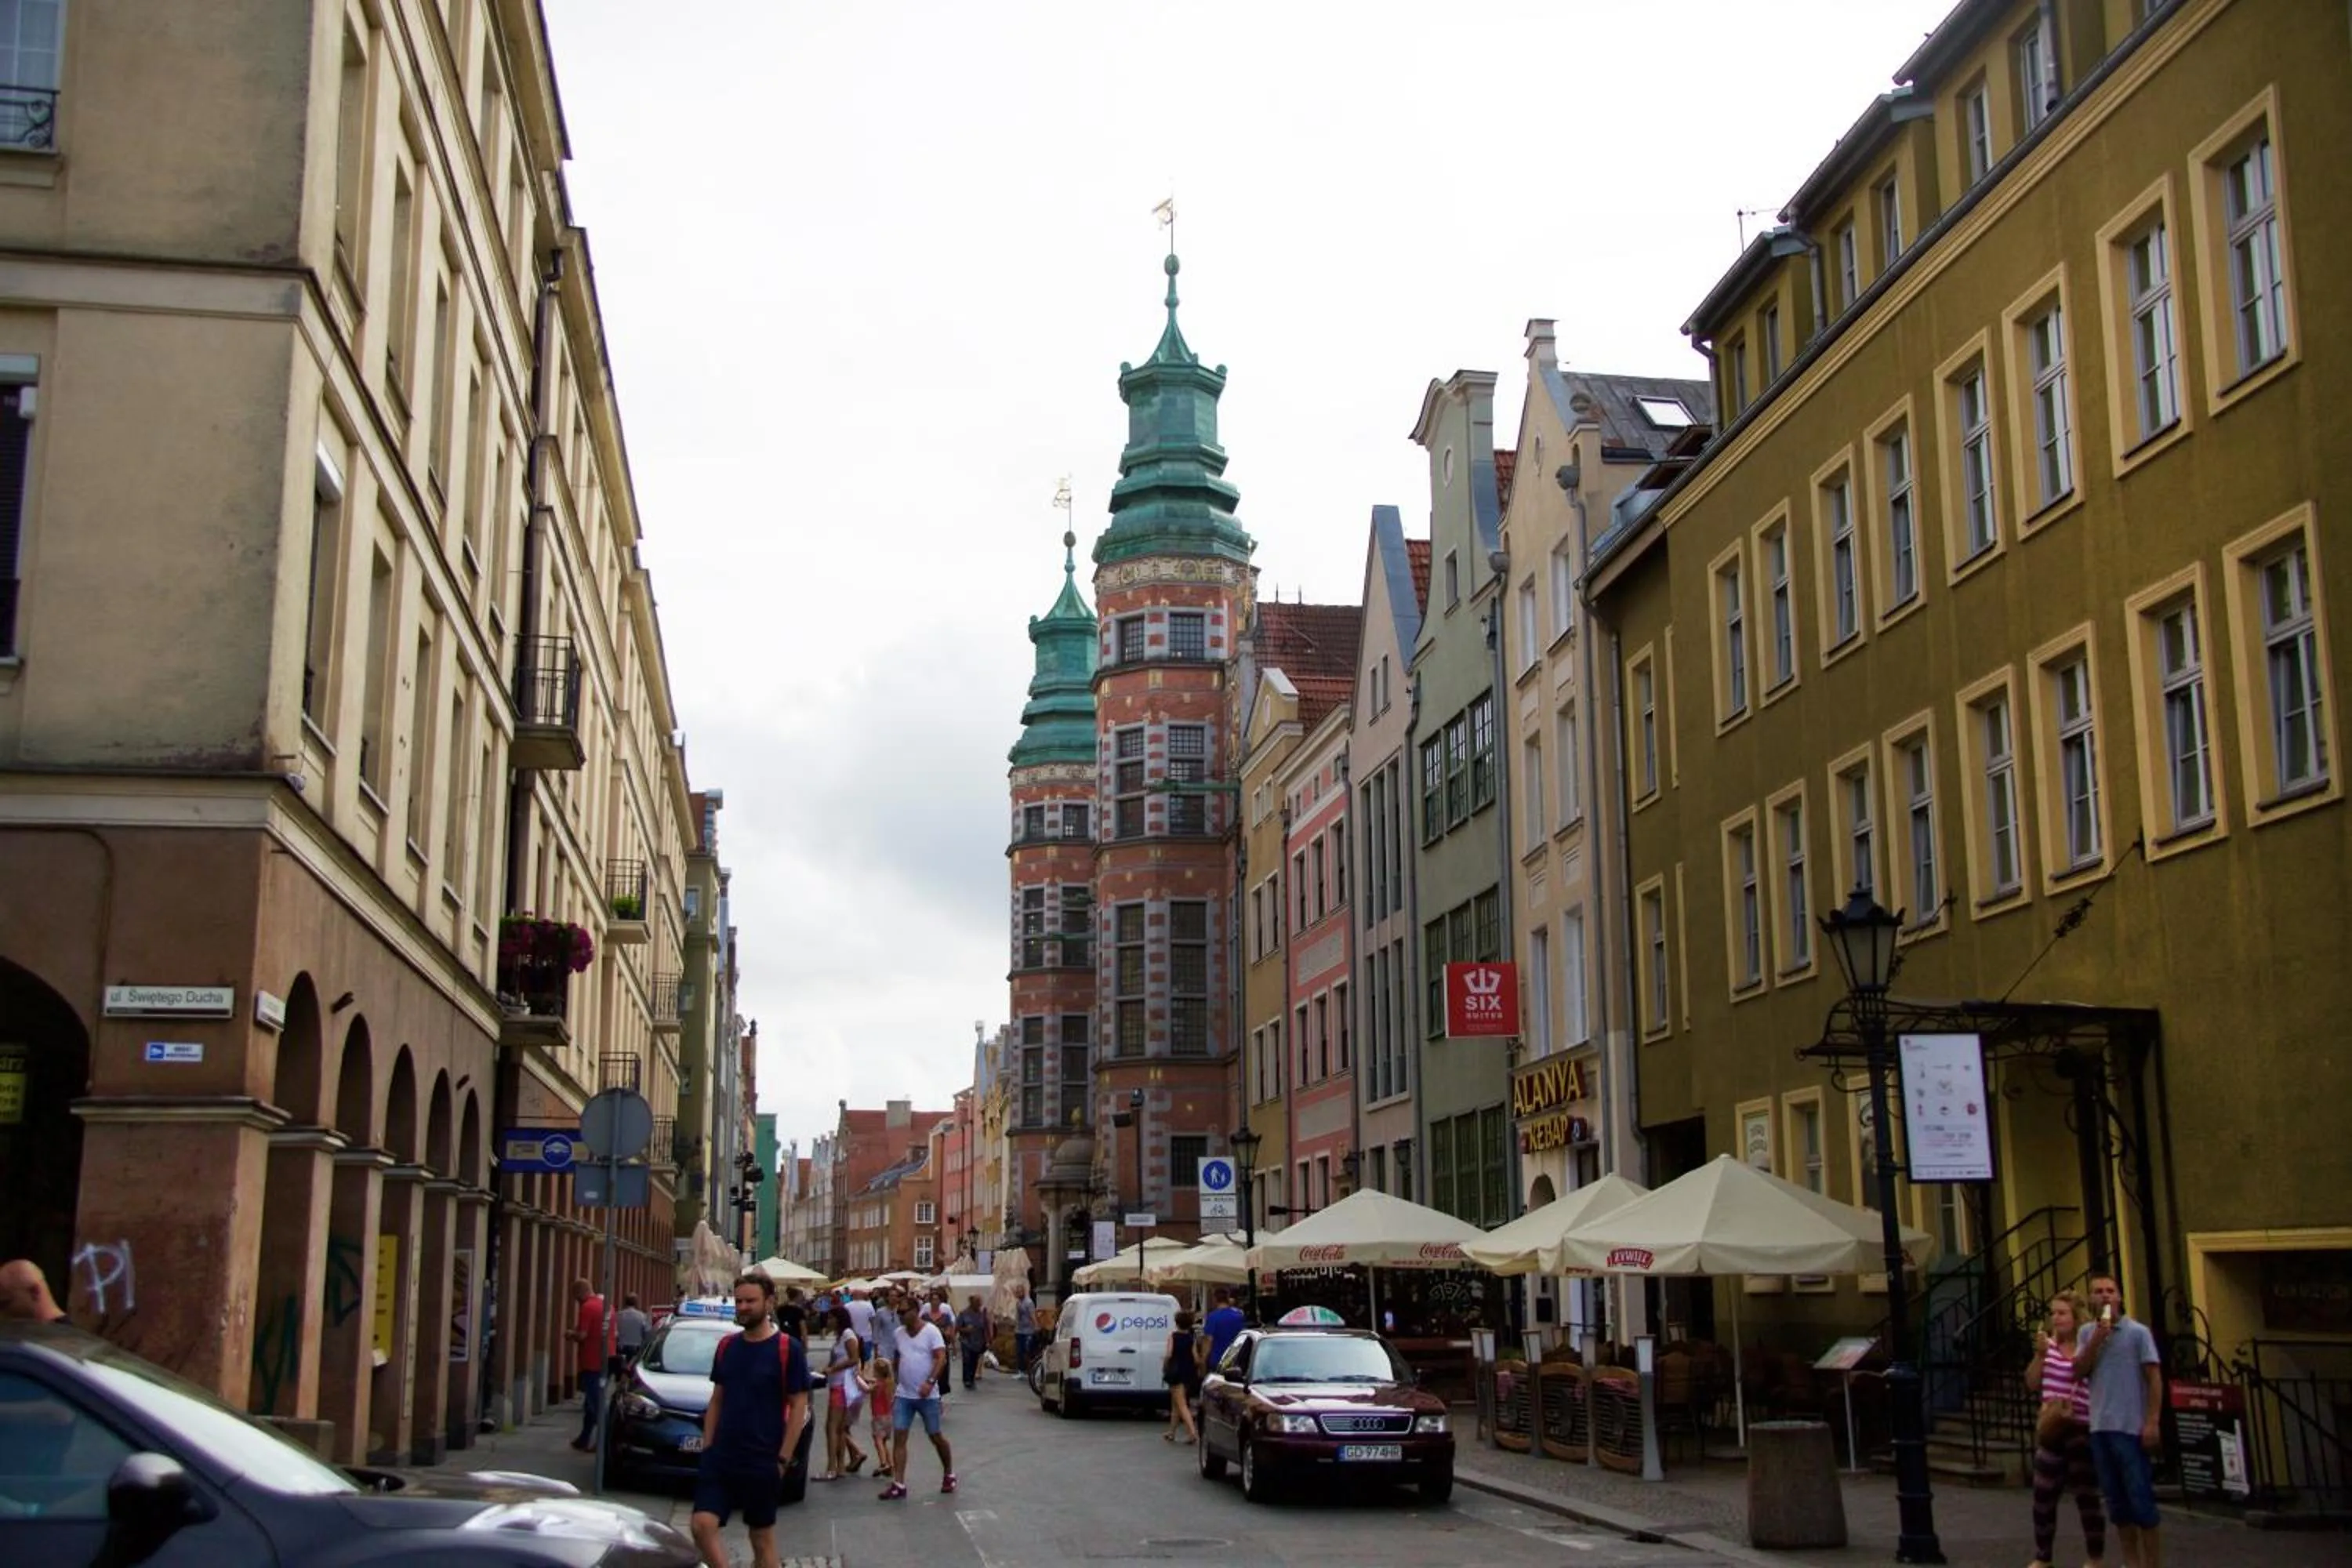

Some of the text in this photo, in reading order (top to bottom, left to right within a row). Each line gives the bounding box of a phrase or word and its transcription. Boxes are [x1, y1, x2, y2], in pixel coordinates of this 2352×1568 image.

[186, 990, 224, 1004] Ducha
[1465, 995, 1502, 1011] SIX
[1513, 1058, 1581, 1116] ALANYA
[1530, 1114, 1568, 1152] KEBAP
[1120, 1314, 1168, 1330] pepsi
[1346, 1446, 1363, 1459] GD
